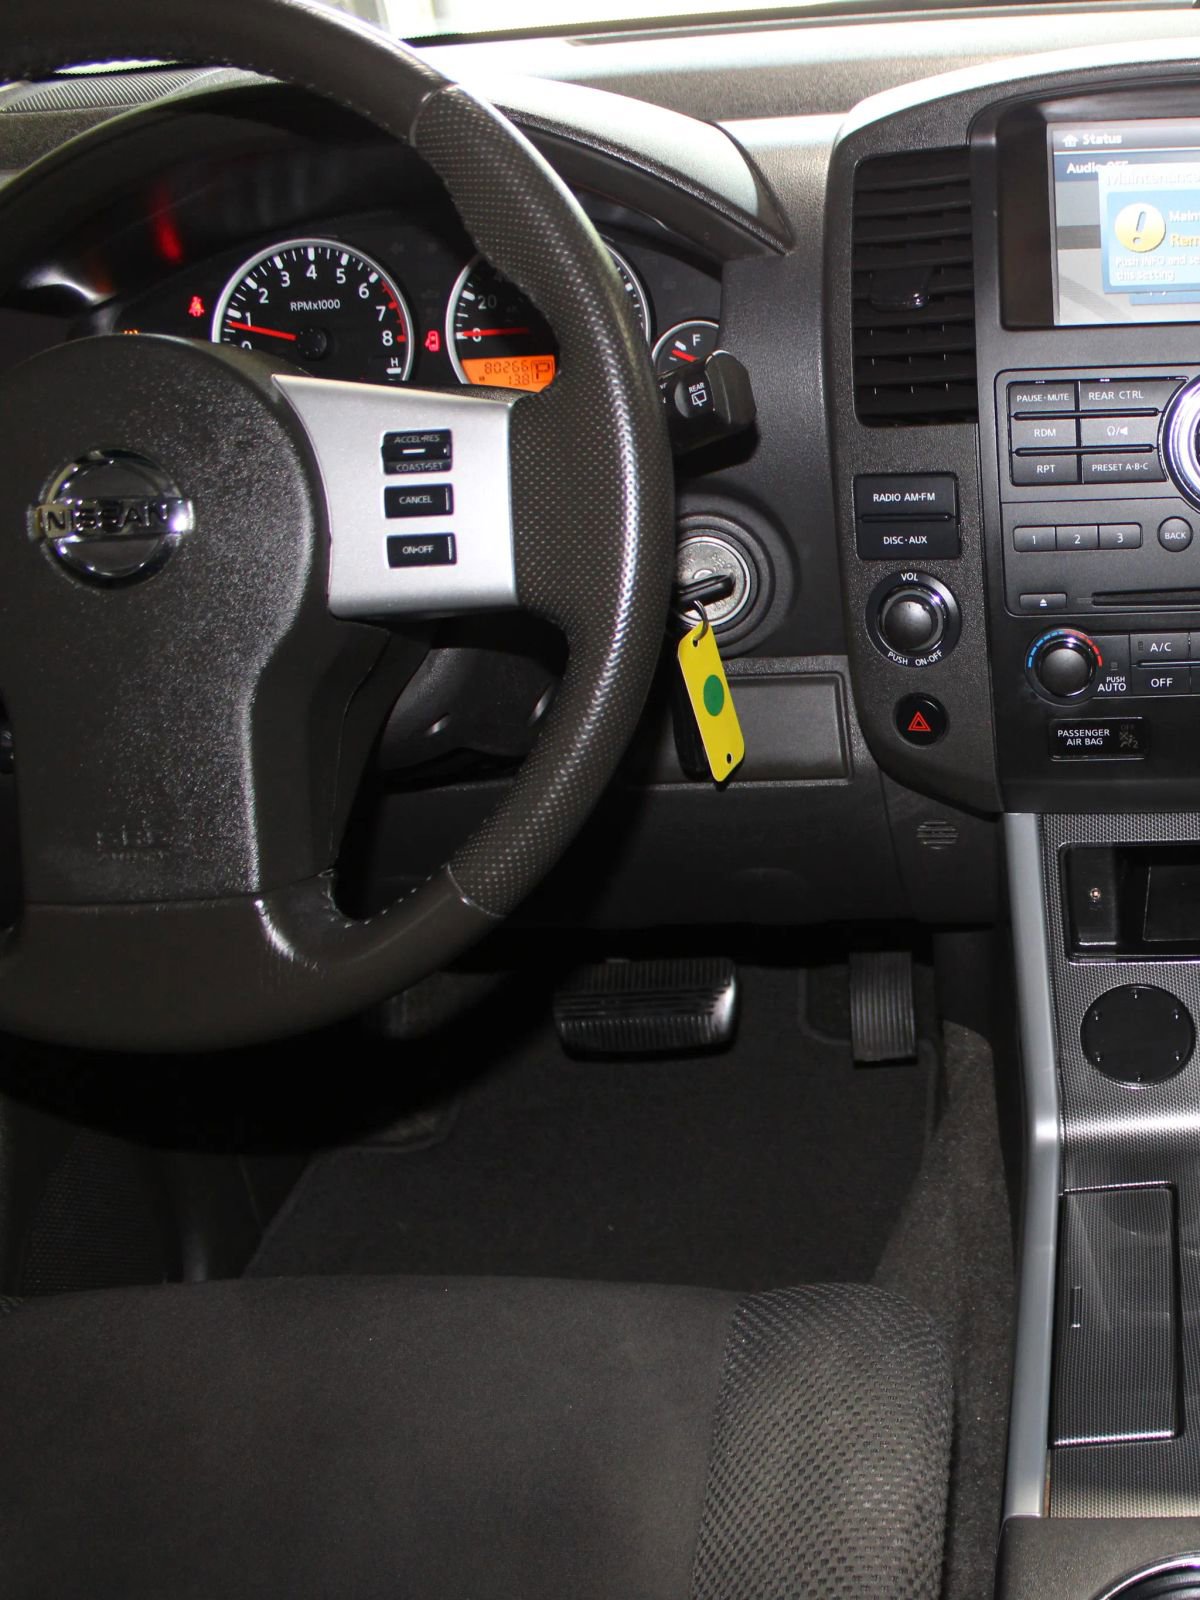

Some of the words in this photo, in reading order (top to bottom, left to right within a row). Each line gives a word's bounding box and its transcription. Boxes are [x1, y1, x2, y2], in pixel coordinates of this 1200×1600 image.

[1082, 134, 1122, 145] Status
[1106, 171, 1200, 186] Maintenance
[306, 264, 317, 280] 4
[336, 268, 346, 284] 5
[281, 272, 291, 287] 3
[258, 287, 269, 304] 2
[358, 283, 370, 299] 6
[290, 299, 341, 312] RPMx1000
[477, 294, 497, 310] 20
[376, 306, 386, 322] 7
[382, 330, 393, 346] 8
[692, 334, 701, 347] F
[391, 358, 398, 367] H
[484, 360, 529, 375] 80266
[535, 363, 551, 380] P
[688, 382, 705, 393] REAR
[1088, 391, 1115, 400] REAR
[1118, 390, 1144, 399] CTRL
[1034, 428, 1056, 437] RDM
[1036, 464, 1056, 473] RPT
[1091, 463, 1123, 472] PRESET
[399, 495, 433, 504] CANCEL
[873, 493, 901, 502] RADIO
[1032, 535, 1037, 544] 1
[1074, 534, 1081, 544] 2
[1117, 533, 1124, 543] 3
[1164, 531, 1187, 540] BACK
[900, 572, 919, 582] VOL
[1150, 642, 1172, 652] A/C
[887, 650, 908, 665] PUSH
[1097, 683, 1127, 692] AUTO
[1150, 678, 1173, 687] OFF
[1057, 728, 1110, 738] PASSENGER
[1066, 738, 1082, 746] AIR
[1084, 737, 1103, 746] BAG
